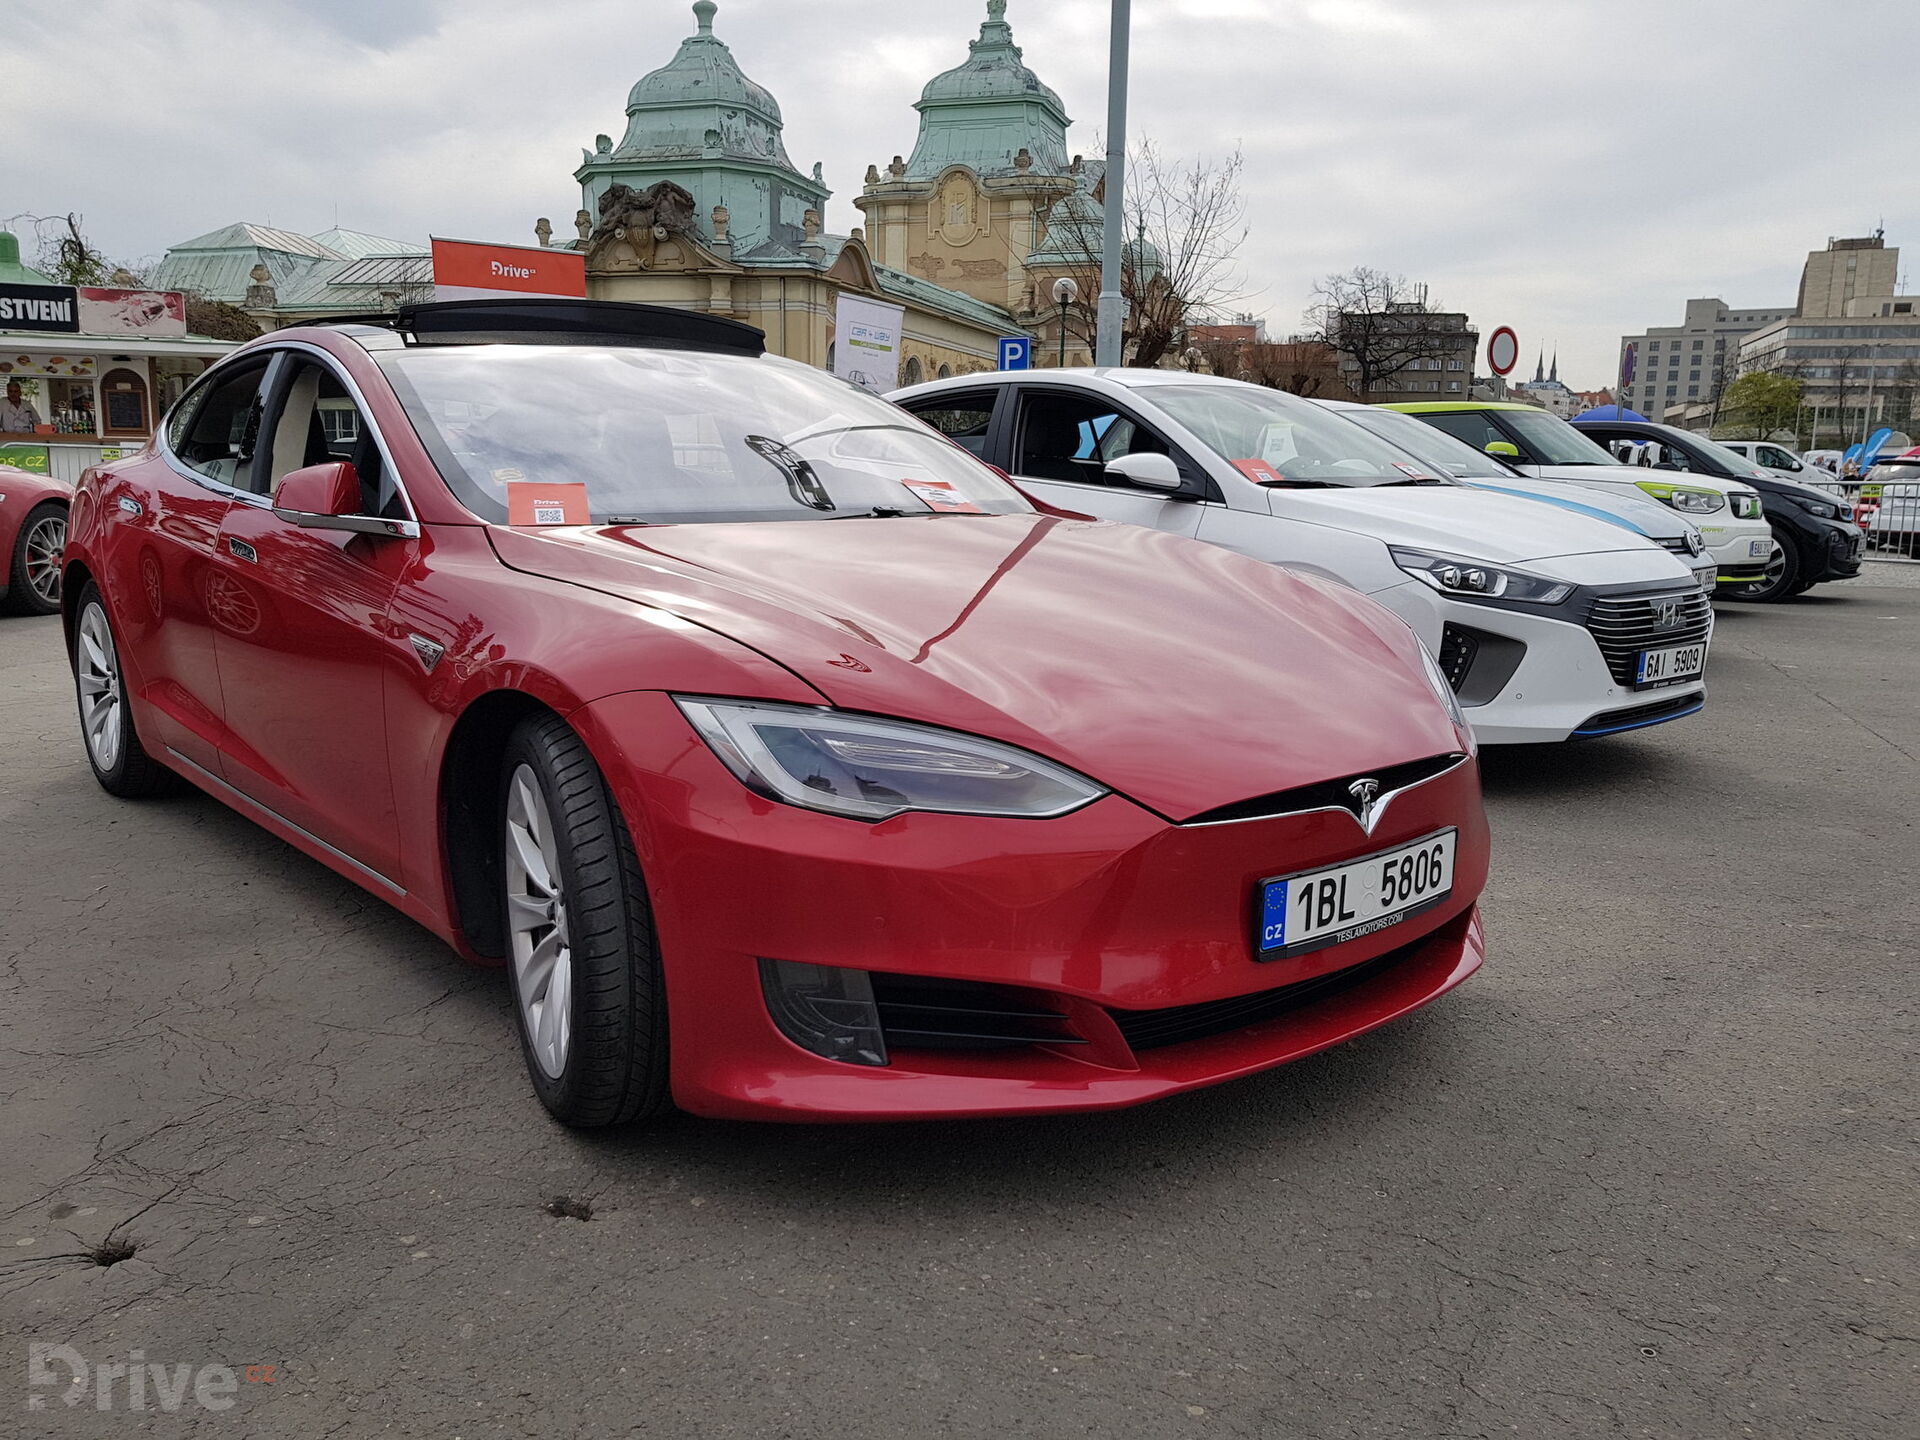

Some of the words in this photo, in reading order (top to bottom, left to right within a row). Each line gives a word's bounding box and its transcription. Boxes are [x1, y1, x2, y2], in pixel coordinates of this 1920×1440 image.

[491, 260, 530, 279] Drive
[0, 297, 72, 322] STVENÍ
[1005, 343, 1023, 370] P
[1674, 648, 1699, 673] 5909
[1297, 874, 1355, 932] 1BL
[1381, 843, 1444, 907] 5806
[1265, 922, 1283, 941] CZ
[1336, 911, 1404, 944] TESLAMOTORS.COM
